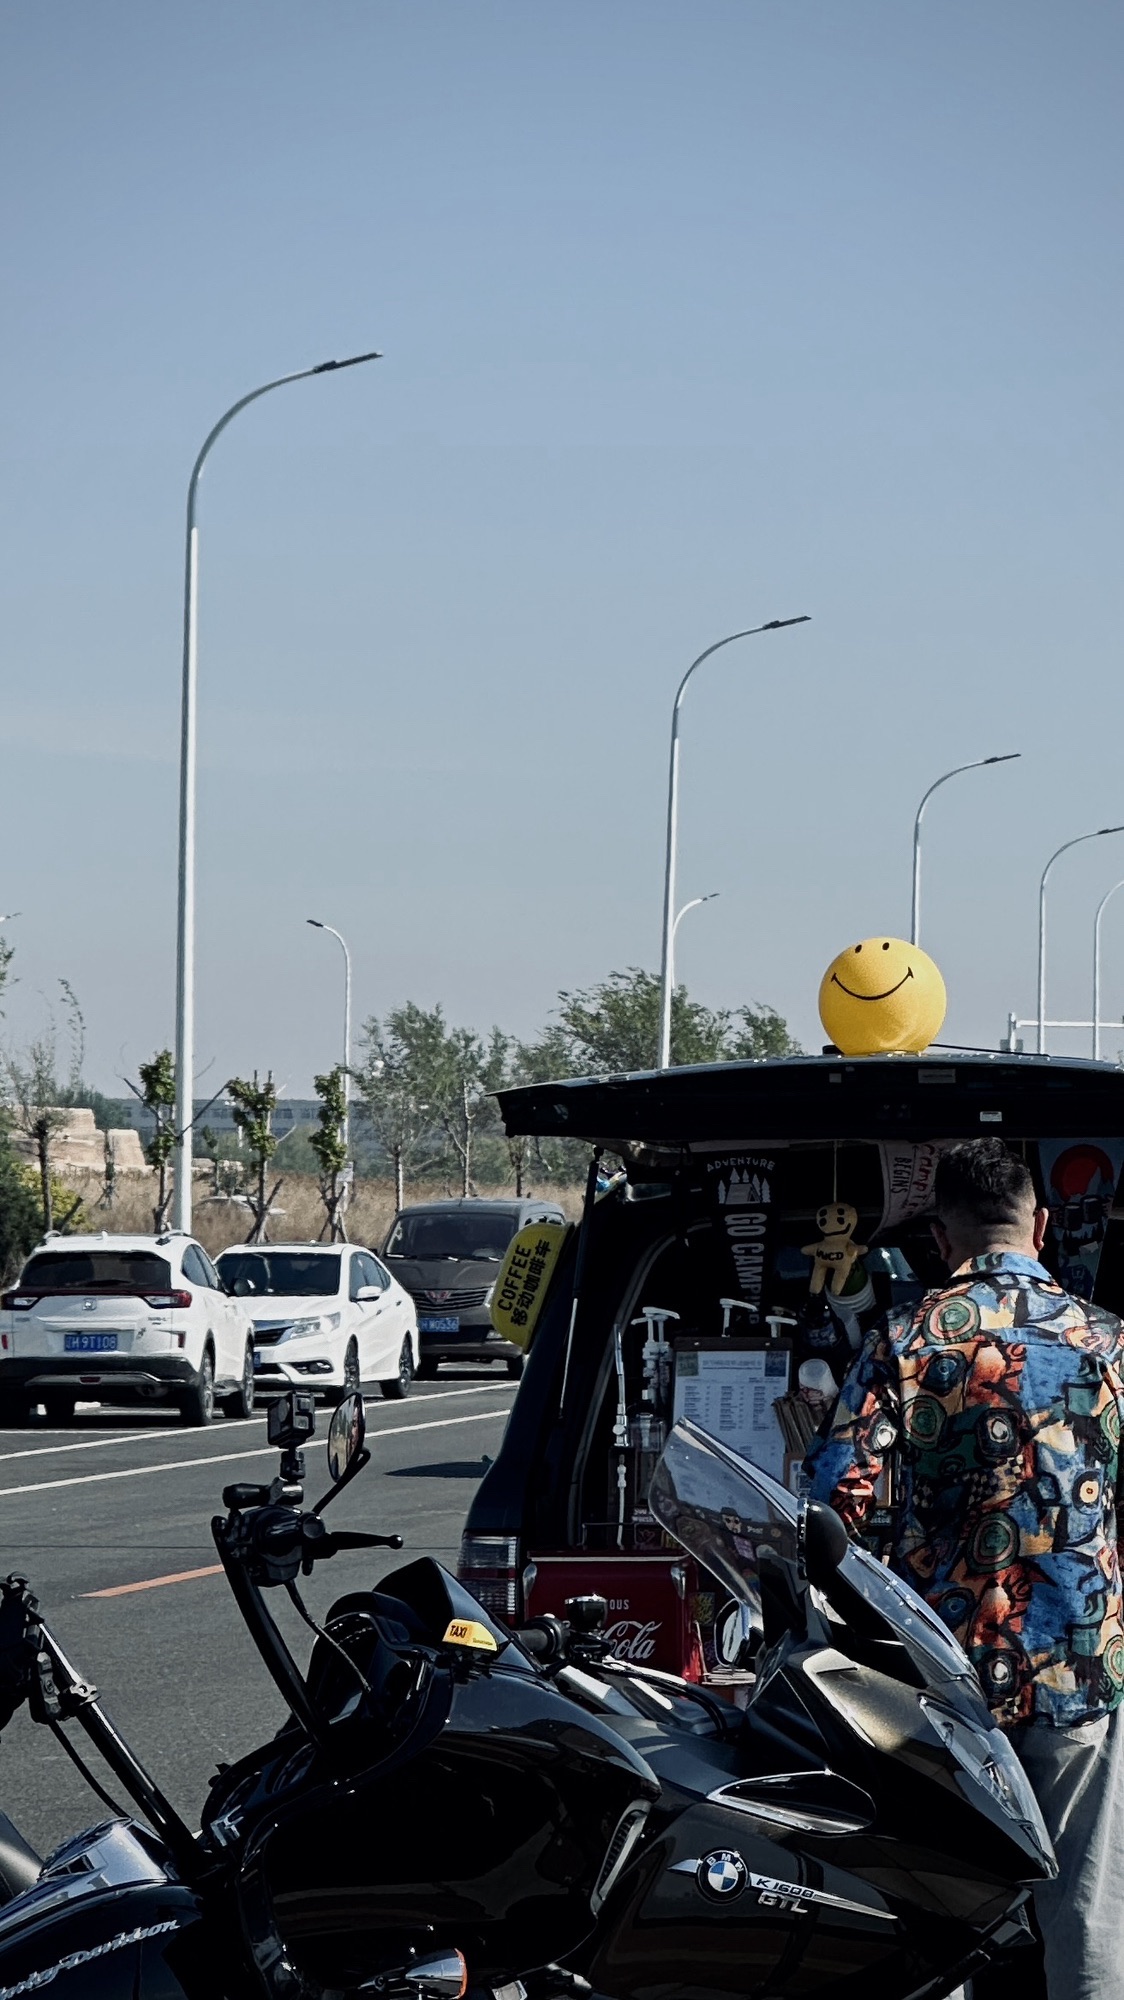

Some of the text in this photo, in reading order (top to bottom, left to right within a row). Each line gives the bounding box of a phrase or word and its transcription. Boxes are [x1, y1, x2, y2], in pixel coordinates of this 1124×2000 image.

[706, 1156, 776, 1173] ADVENTURE
[891, 1157, 912, 1194] BEGINS
[724, 1212, 768, 1237] GO
[497, 1244, 532, 1311] COFFEE
[510, 1239, 551, 1326] 移动咖啡车
[449, 1625, 467, 1639] TAXI
[706, 1853, 744, 1873] BMW
[758, 1890, 808, 1914] GTL
